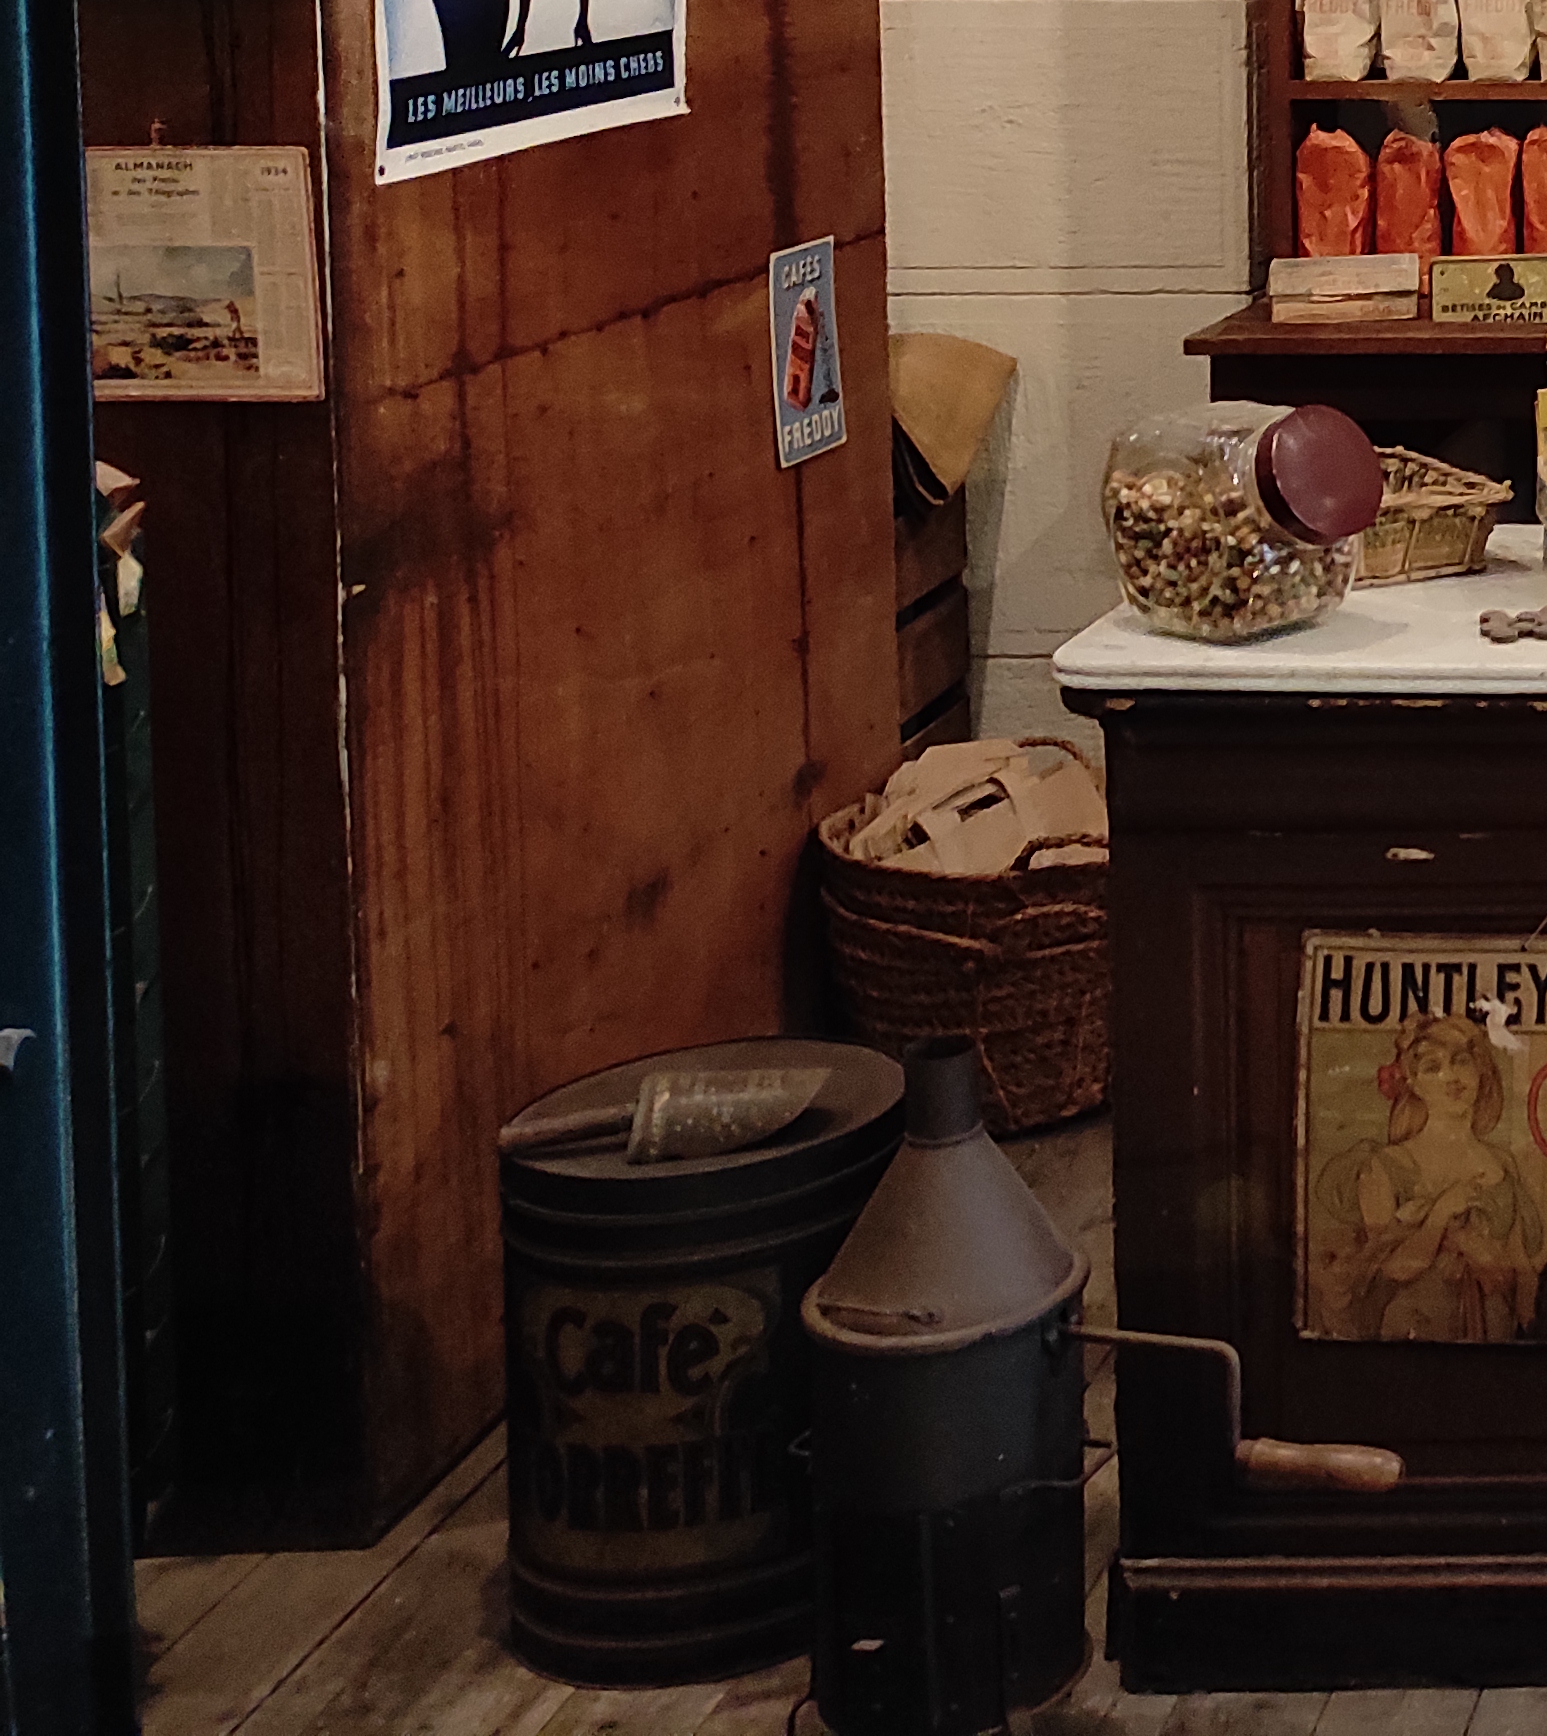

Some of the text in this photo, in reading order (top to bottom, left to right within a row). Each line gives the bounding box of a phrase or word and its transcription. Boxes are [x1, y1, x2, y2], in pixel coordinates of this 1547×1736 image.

[406, 97, 437, 123] LES
[534, 70, 560, 97] LES
[564, 59, 616, 91] MOINS
[114, 160, 194, 173] ALMANACH
[783, 405, 841, 454] FREDDY
[544, 1301, 732, 1398] Café
